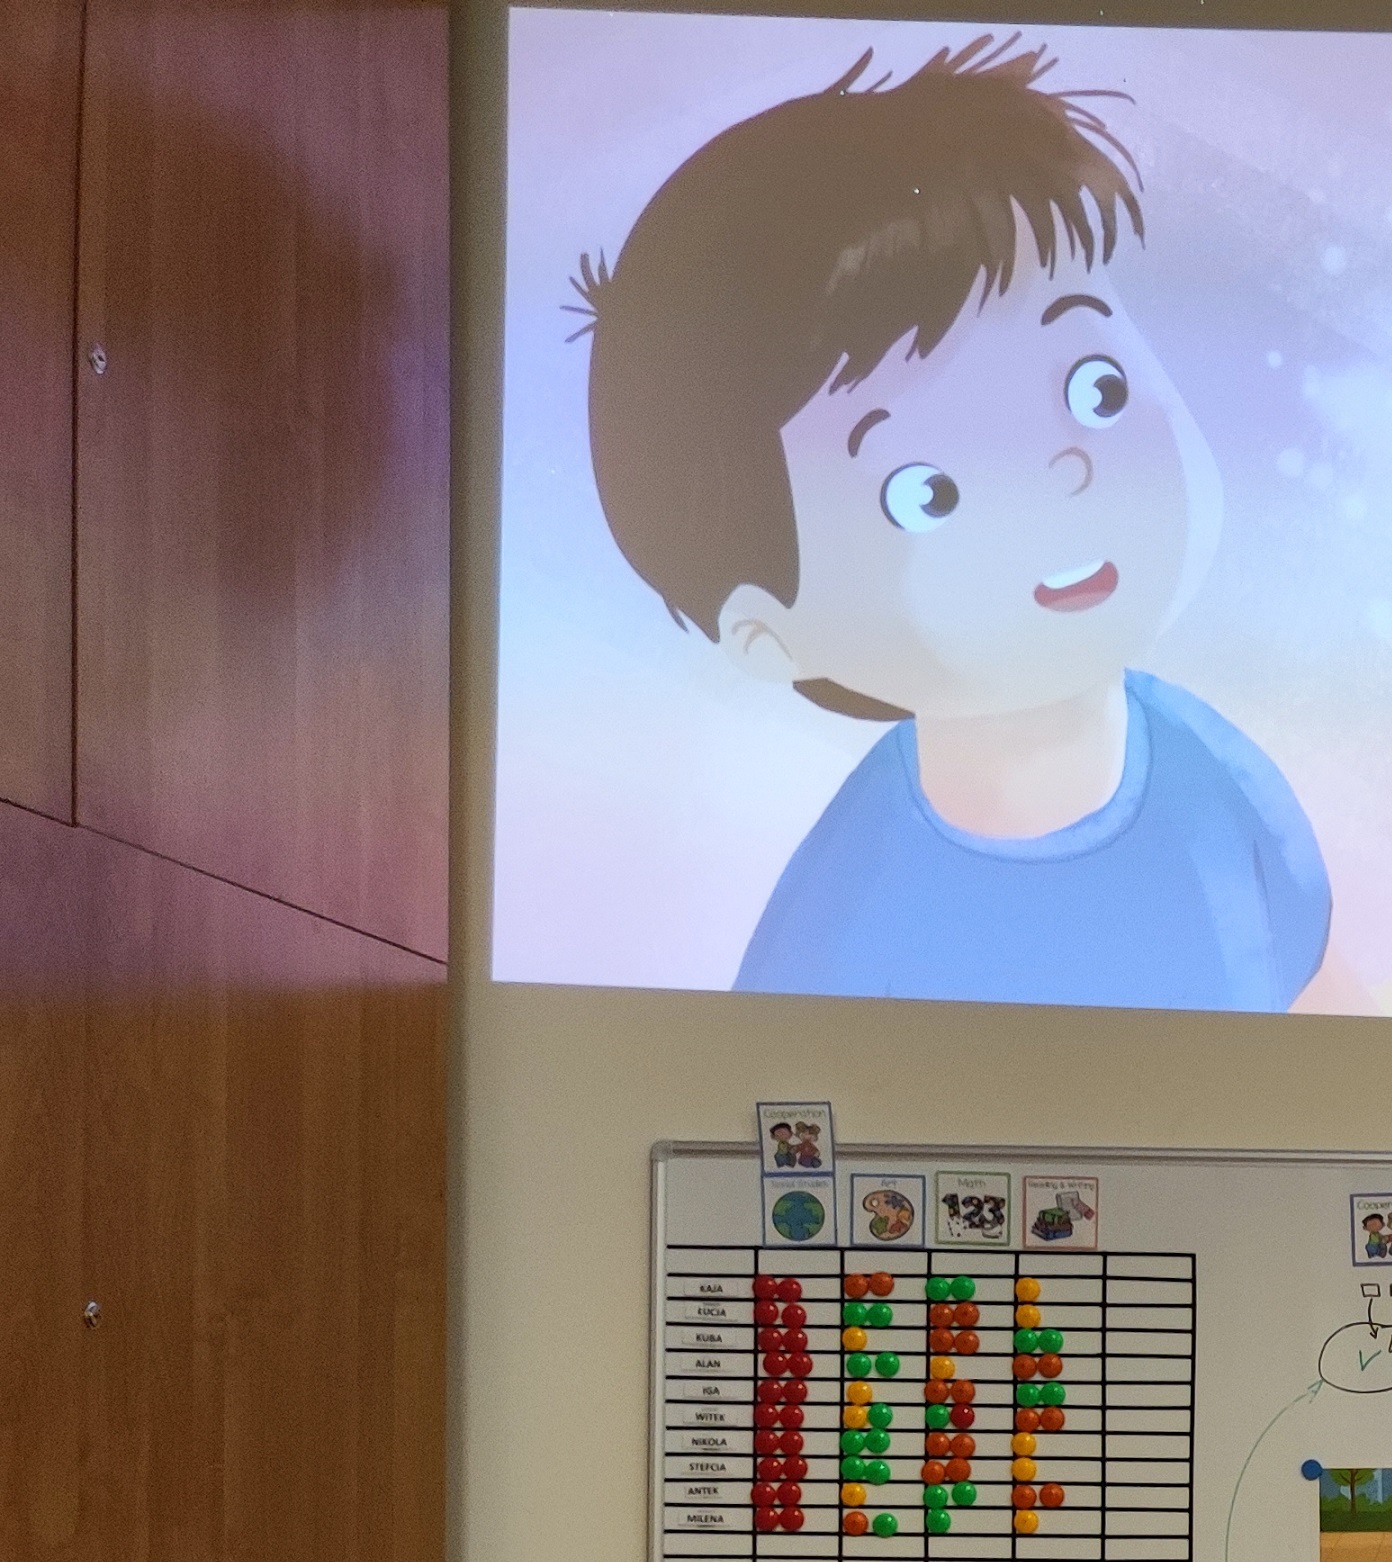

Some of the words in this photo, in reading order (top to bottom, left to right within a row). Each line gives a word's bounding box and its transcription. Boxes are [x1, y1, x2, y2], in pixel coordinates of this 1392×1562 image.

[958, 1178, 986, 1188] Math
[942, 1193, 1006, 1229] 123
[696, 1333, 722, 1342] KUBA
[696, 1360, 720, 1368] ALAN
[702, 1387, 720, 1395] IGA
[695, 1412, 725, 1421] WITEK
[691, 1438, 727, 1446] NIKOLA
[689, 1463, 726, 1472] STEFCIA
[688, 1487, 719, 1495] ANTEK
[687, 1515, 724, 1523] MILENA
